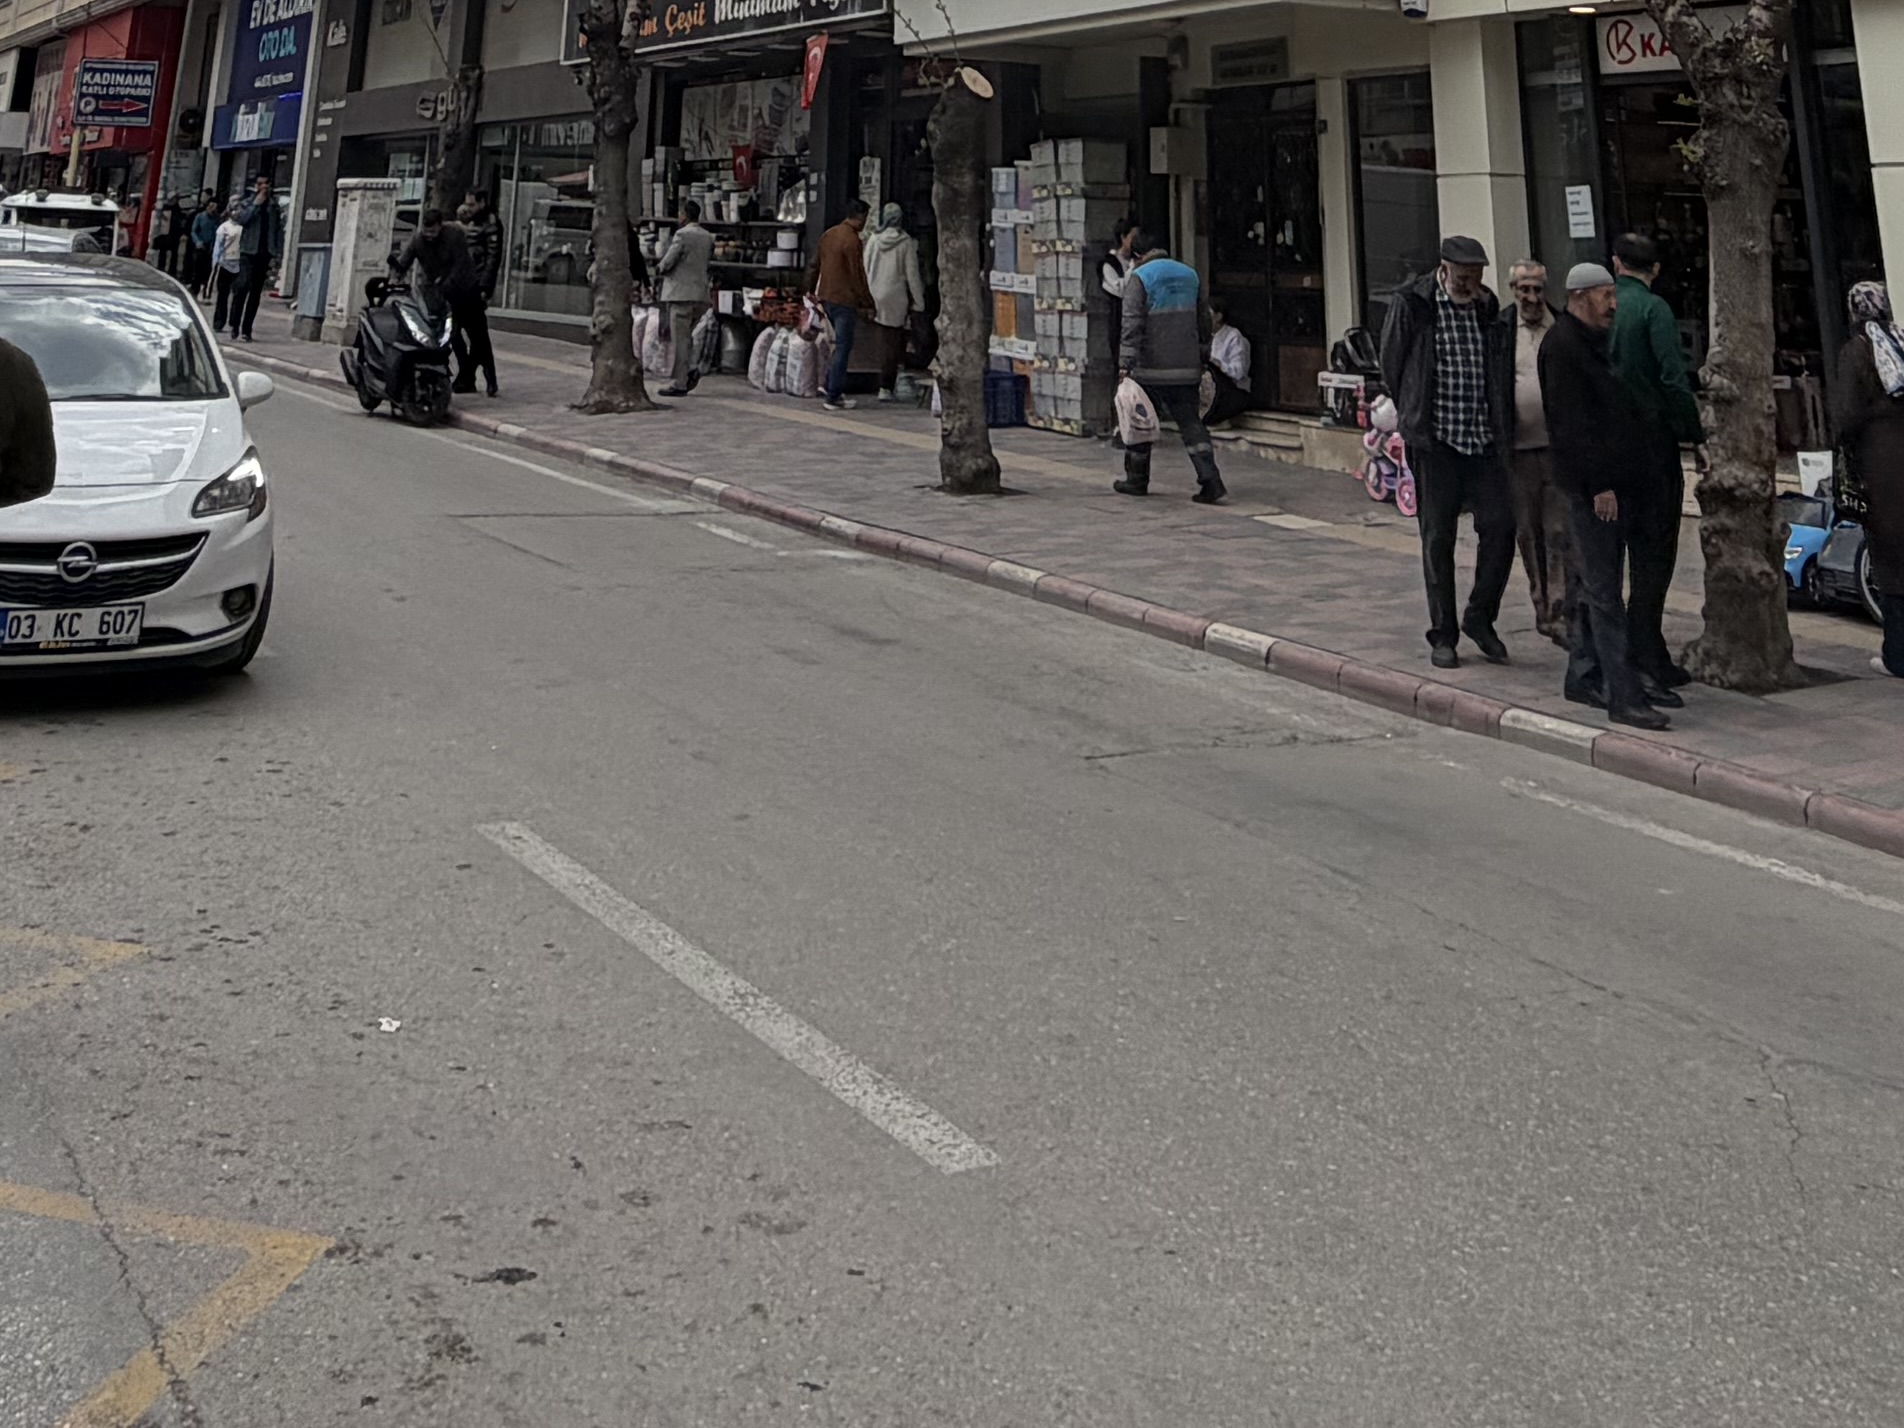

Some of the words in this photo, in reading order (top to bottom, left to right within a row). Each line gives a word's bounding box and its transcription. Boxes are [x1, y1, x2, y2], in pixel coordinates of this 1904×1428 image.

[663, 1, 708, 38] Çeşit
[82, 71, 153, 87] KADINANA
[7, 613, 37, 640] 03
[52, 612, 83, 639] KC
[97, 608, 140, 636] 607
